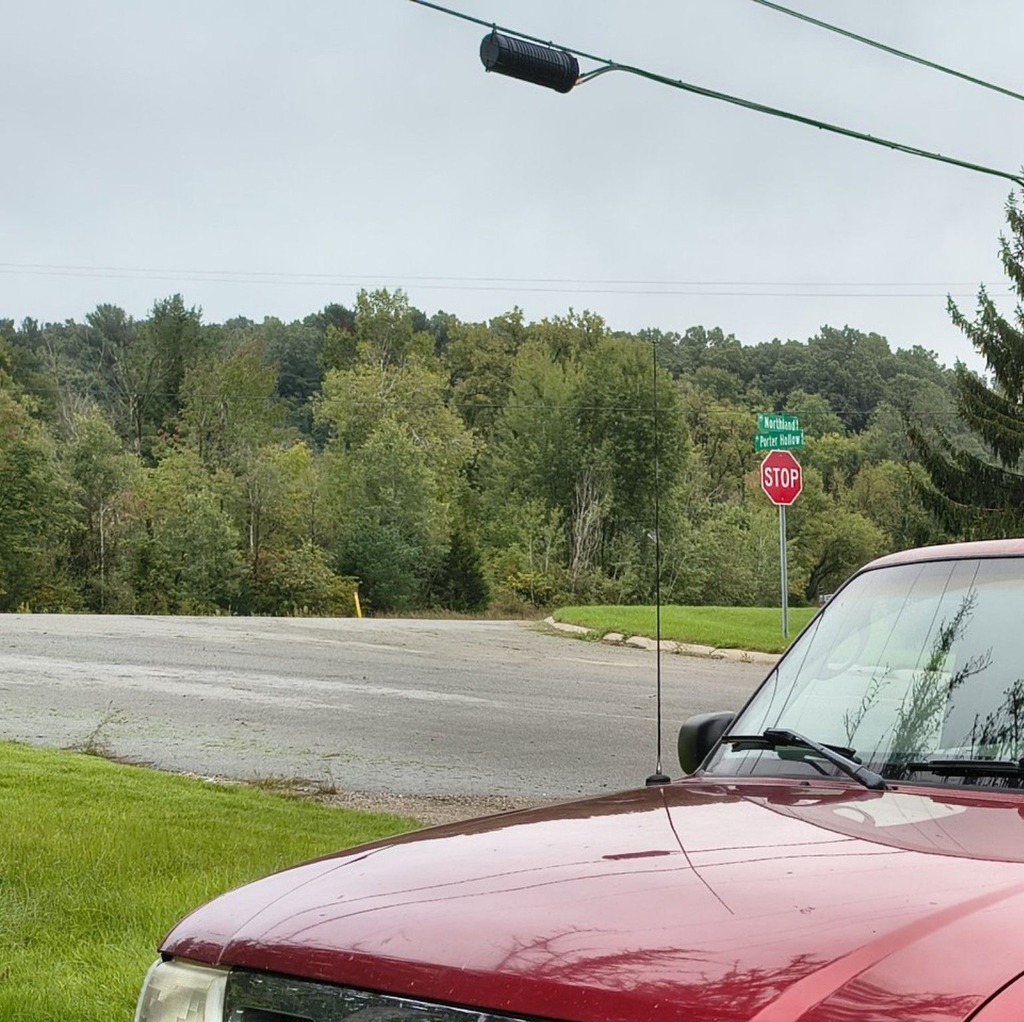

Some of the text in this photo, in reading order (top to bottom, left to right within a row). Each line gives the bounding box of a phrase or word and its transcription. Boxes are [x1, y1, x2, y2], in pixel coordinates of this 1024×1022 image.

[764, 416, 795, 431] Northland
[759, 435, 778, 448] Porter
[779, 434, 800, 446] Hollow
[764, 467, 799, 488] STOP
